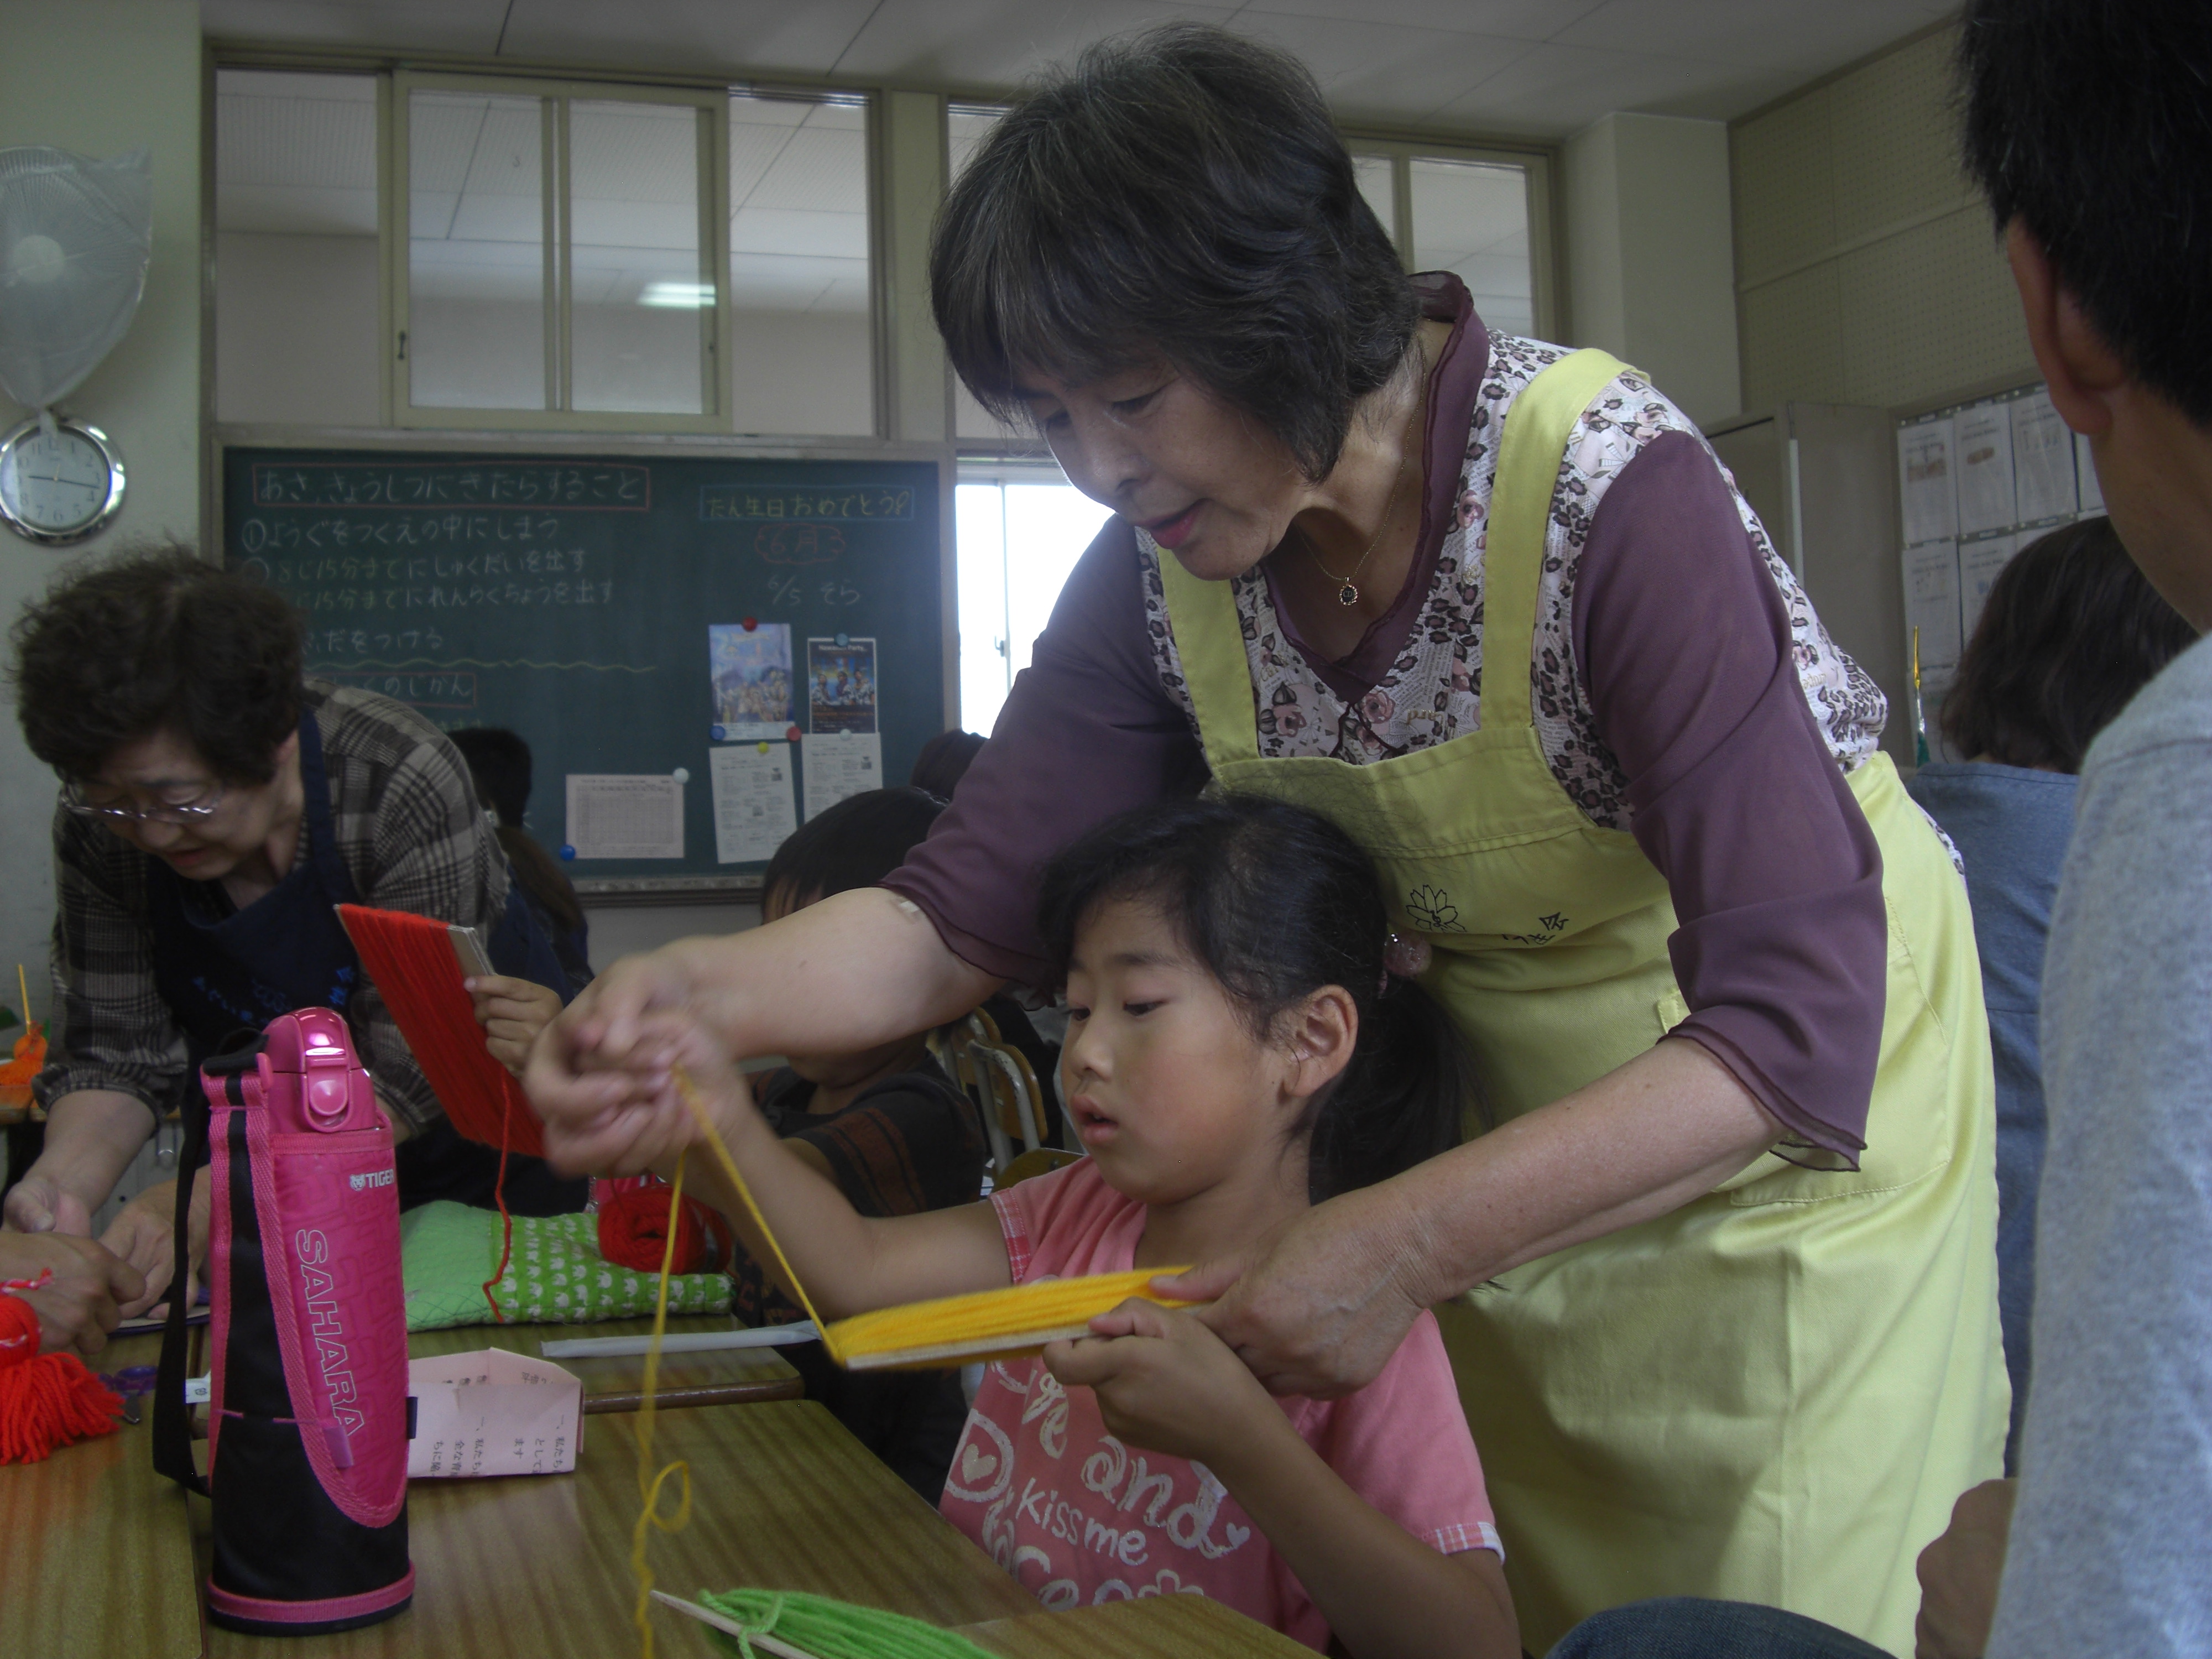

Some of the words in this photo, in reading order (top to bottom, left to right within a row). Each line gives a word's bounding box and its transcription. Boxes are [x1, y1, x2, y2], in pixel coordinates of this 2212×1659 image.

[770, 527, 817, 554] 6月
[295, 1229, 365, 1437] SAHARA
[1083, 1517, 1149, 1566] me
